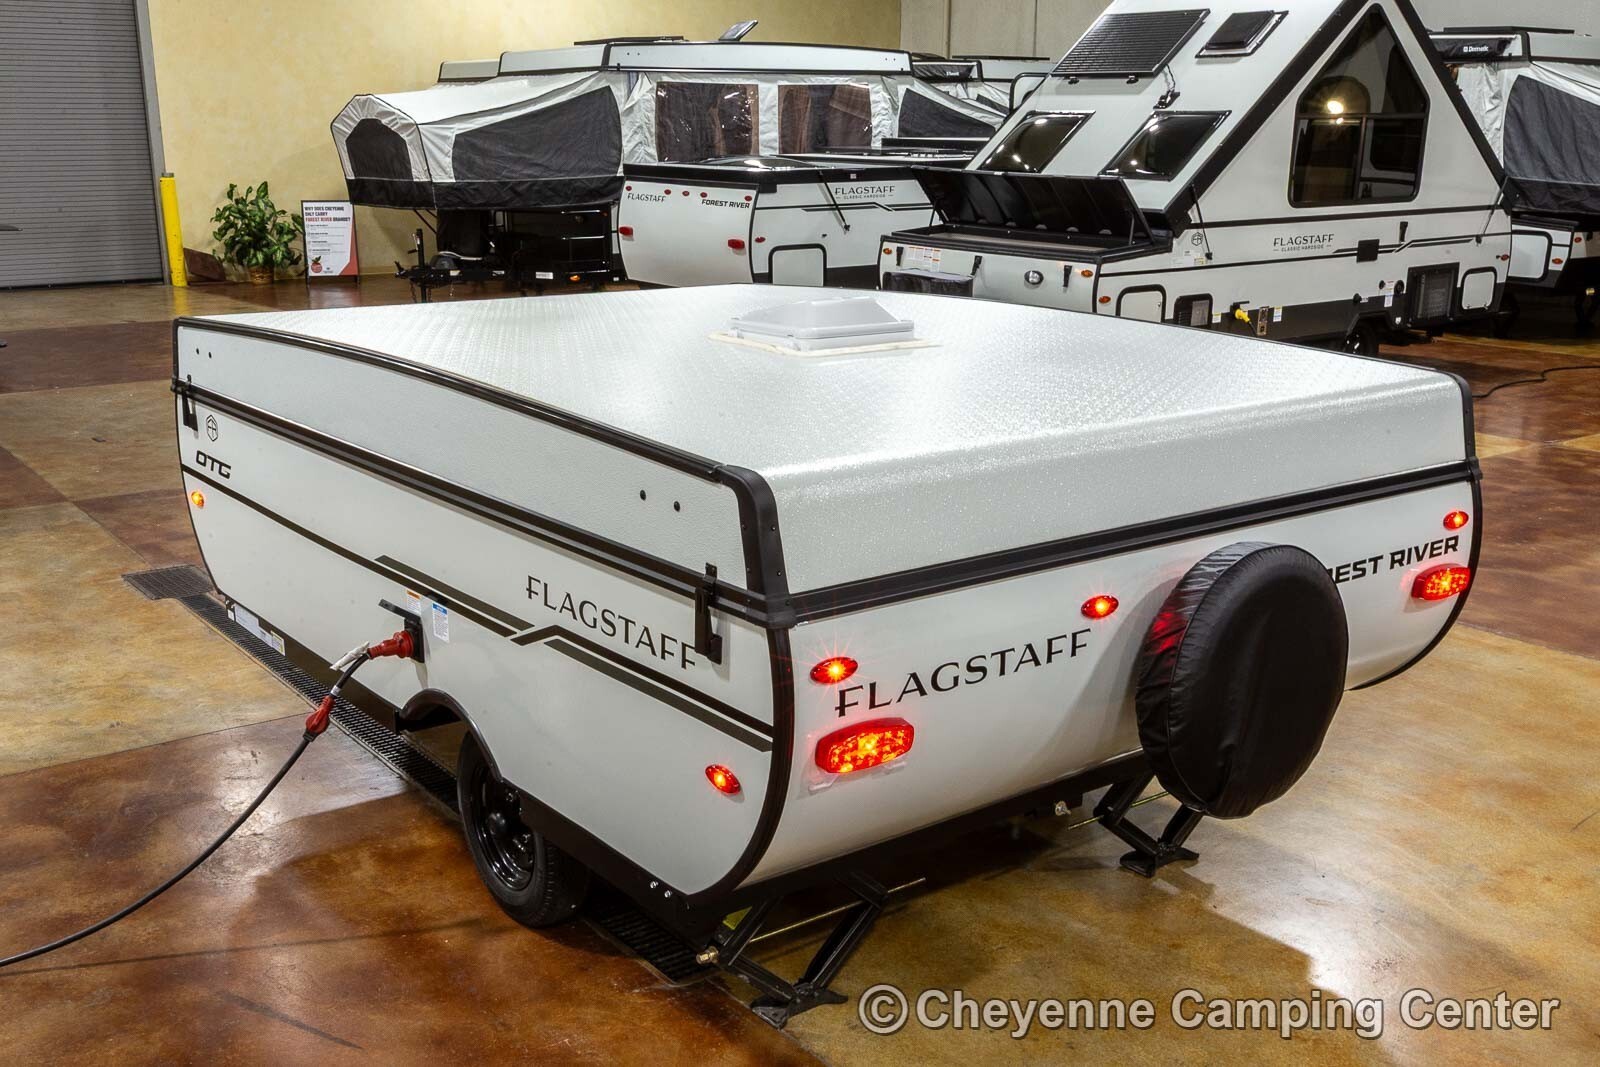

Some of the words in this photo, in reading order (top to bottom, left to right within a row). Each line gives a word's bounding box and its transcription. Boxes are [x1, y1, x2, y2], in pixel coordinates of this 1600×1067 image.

[627, 192, 666, 203] FLAGSTAFF
[834, 185, 896, 196] FLAGSTAFF
[701, 199, 728, 208] FOREST
[729, 200, 750, 209] RIVER
[1273, 233, 1335, 247] FLAGSTAFF
[196, 450, 232, 480] OTG
[1389, 535, 1460, 570] RIVER
[526, 575, 696, 670] FLAGSTAFF
[834, 628, 1092, 718] FLAGSTAFF
